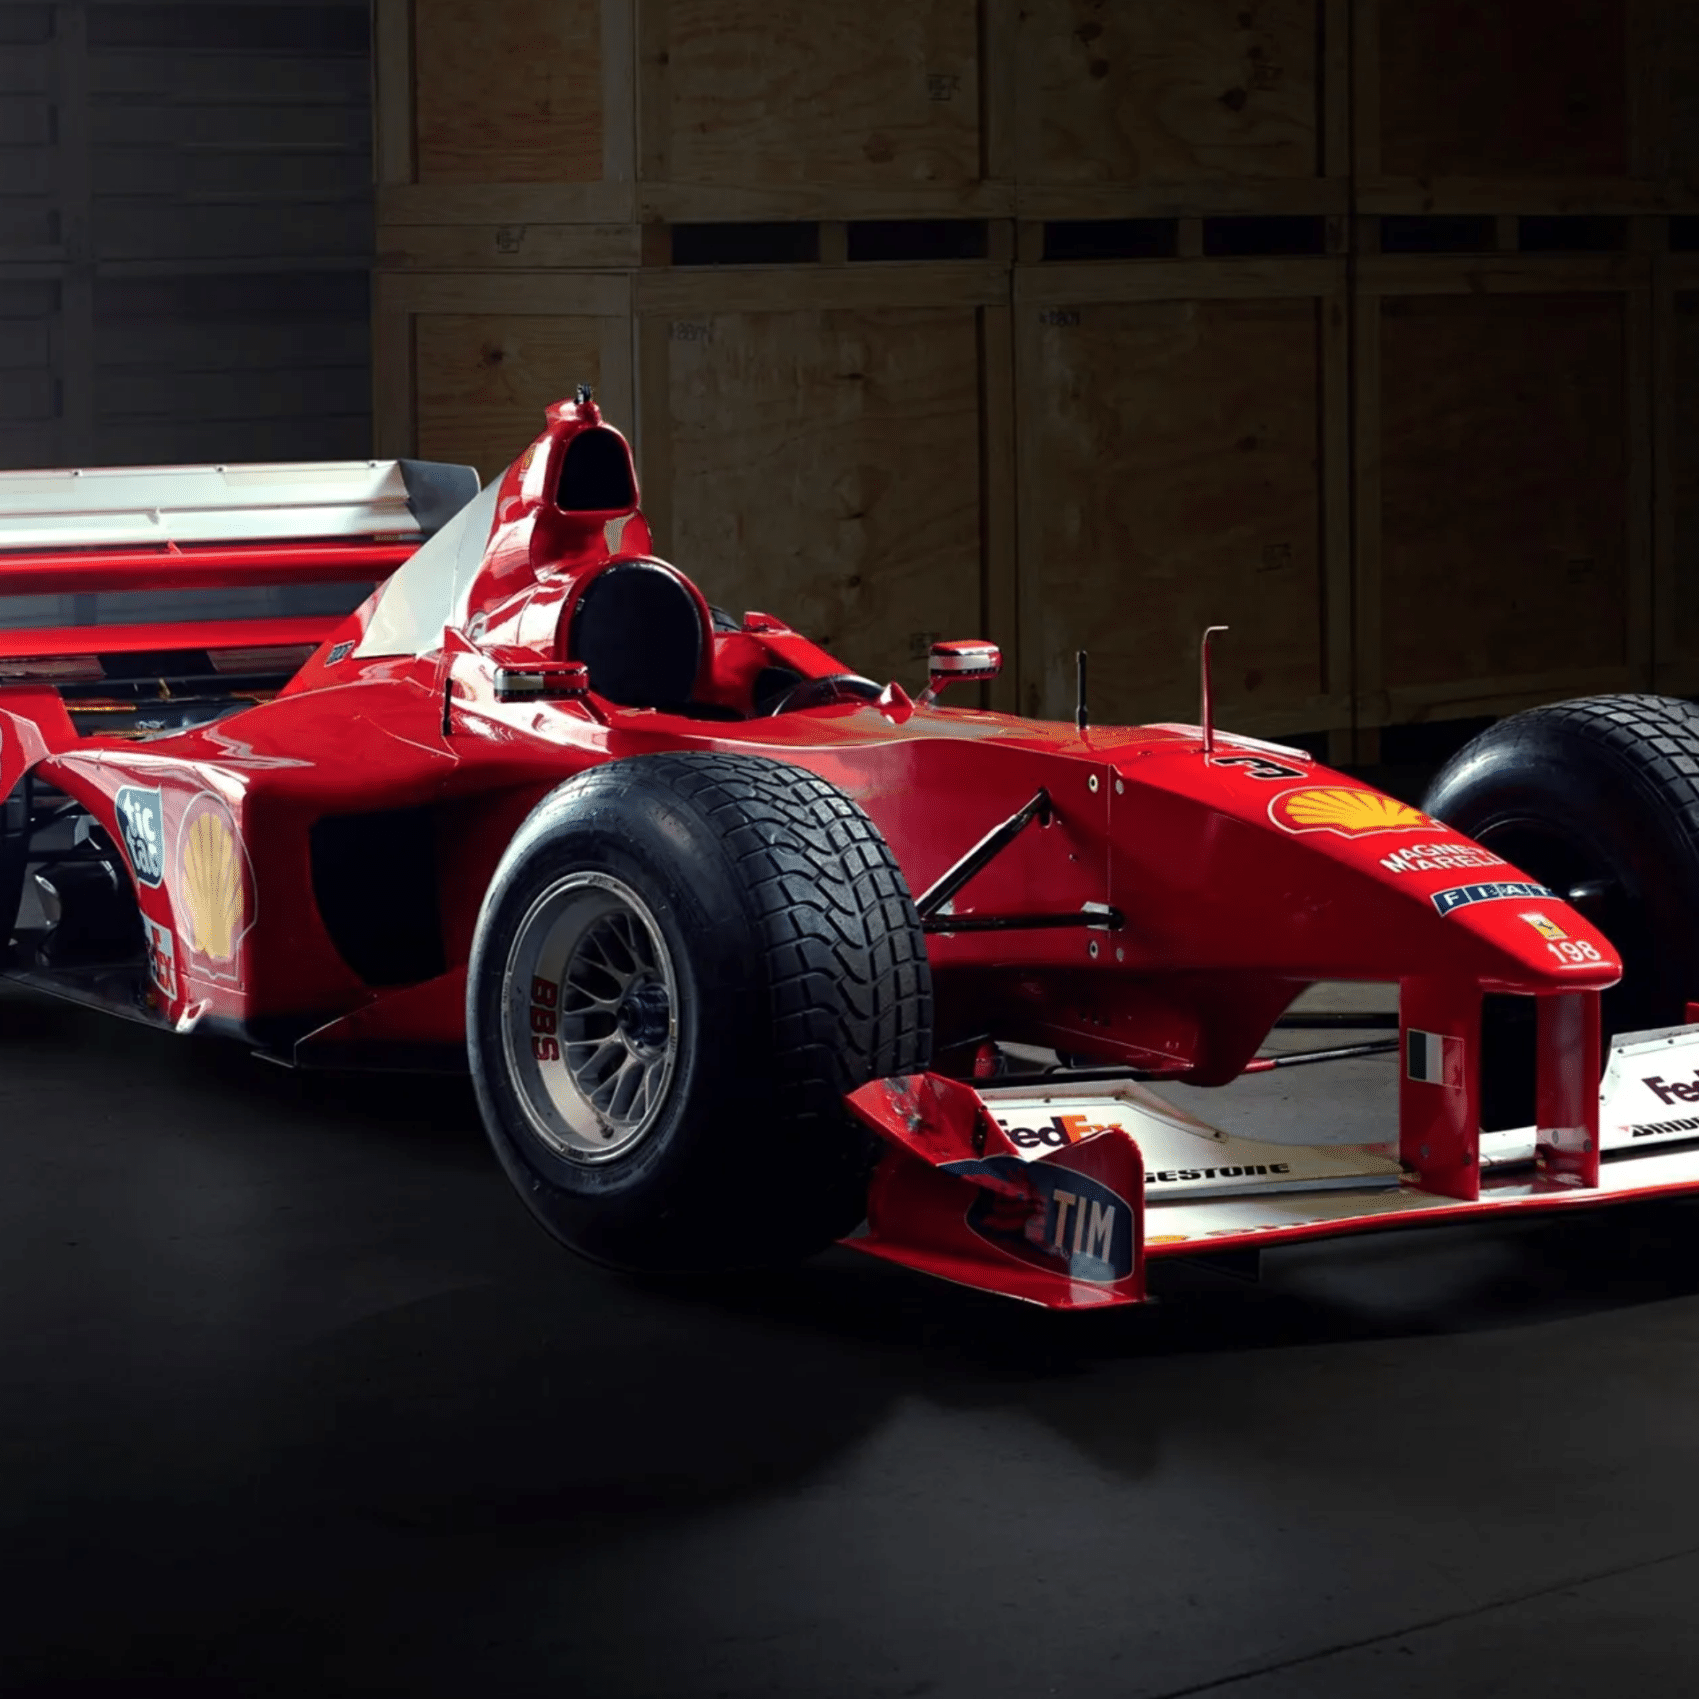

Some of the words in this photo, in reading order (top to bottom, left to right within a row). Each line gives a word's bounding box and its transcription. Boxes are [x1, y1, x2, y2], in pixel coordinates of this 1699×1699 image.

[1209, 756, 1308, 780] 3
[123, 791, 156, 842] tic
[126, 825, 161, 878] tac
[1443, 883, 1552, 906] FIAT
[1546, 940, 1602, 964] 198
[530, 975, 560, 1061] BBS
[1641, 1069, 1699, 1105] Fe
[1053, 1188, 1117, 1264] TIM
